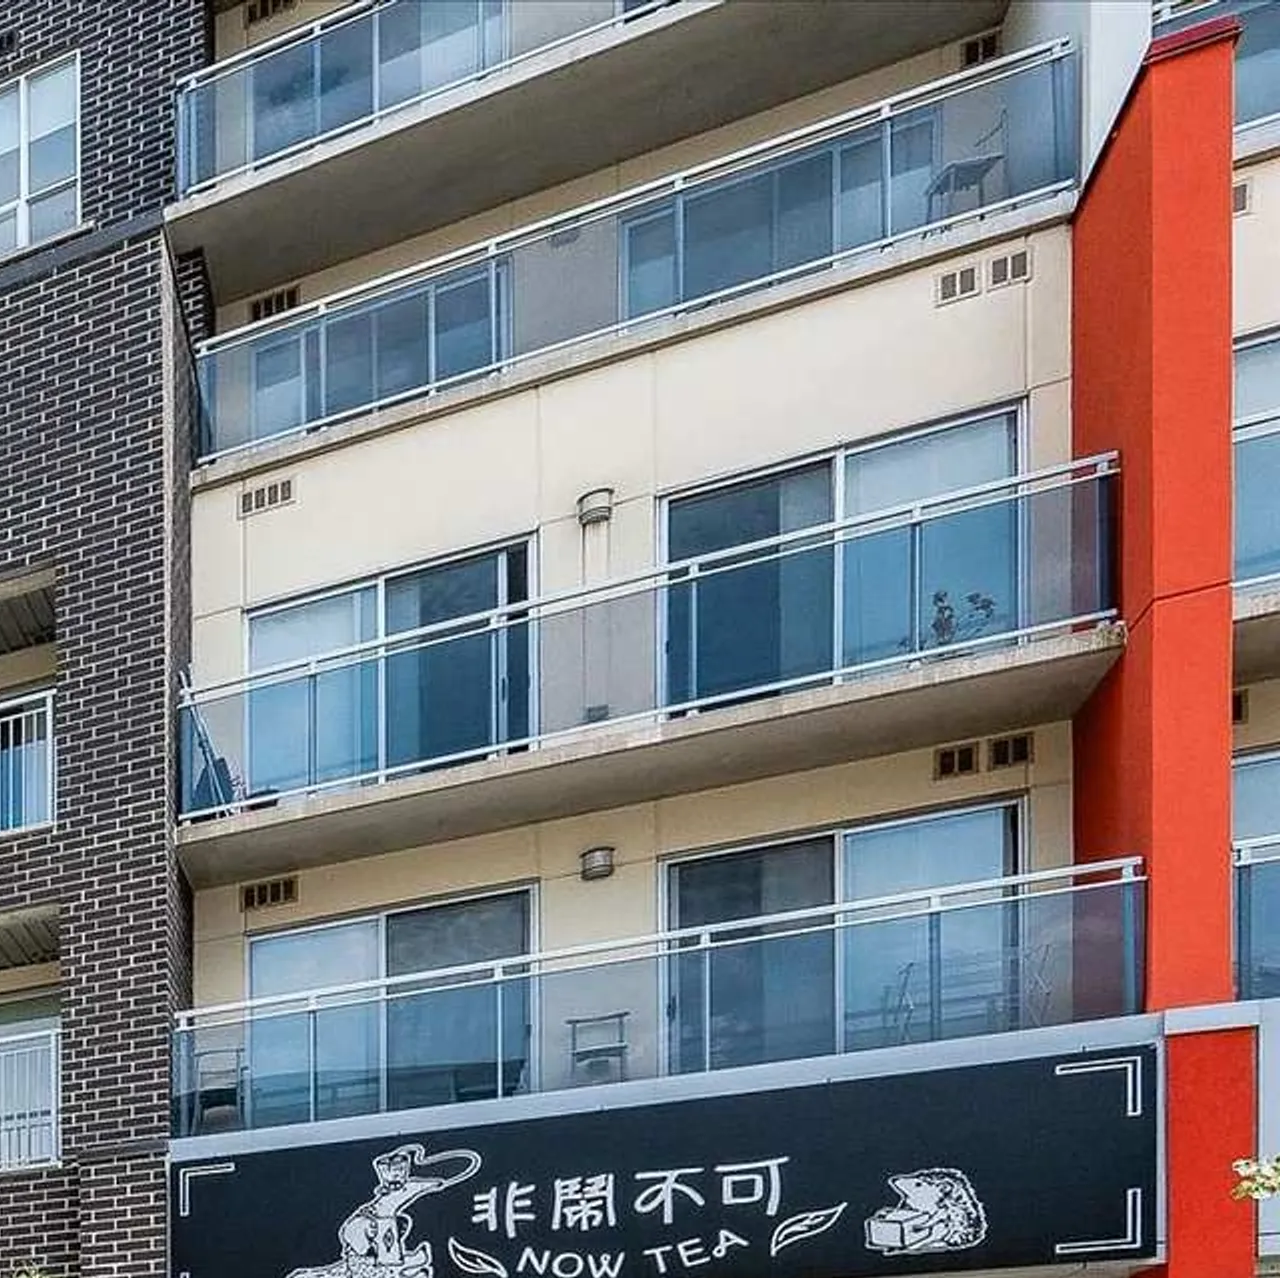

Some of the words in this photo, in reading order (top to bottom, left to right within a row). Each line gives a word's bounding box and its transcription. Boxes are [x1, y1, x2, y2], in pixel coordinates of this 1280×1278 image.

[471, 1157, 790, 1238] 非鬧不可
[516, 1247, 625, 1278] NOW
[644, 1230, 749, 1274] TEA
